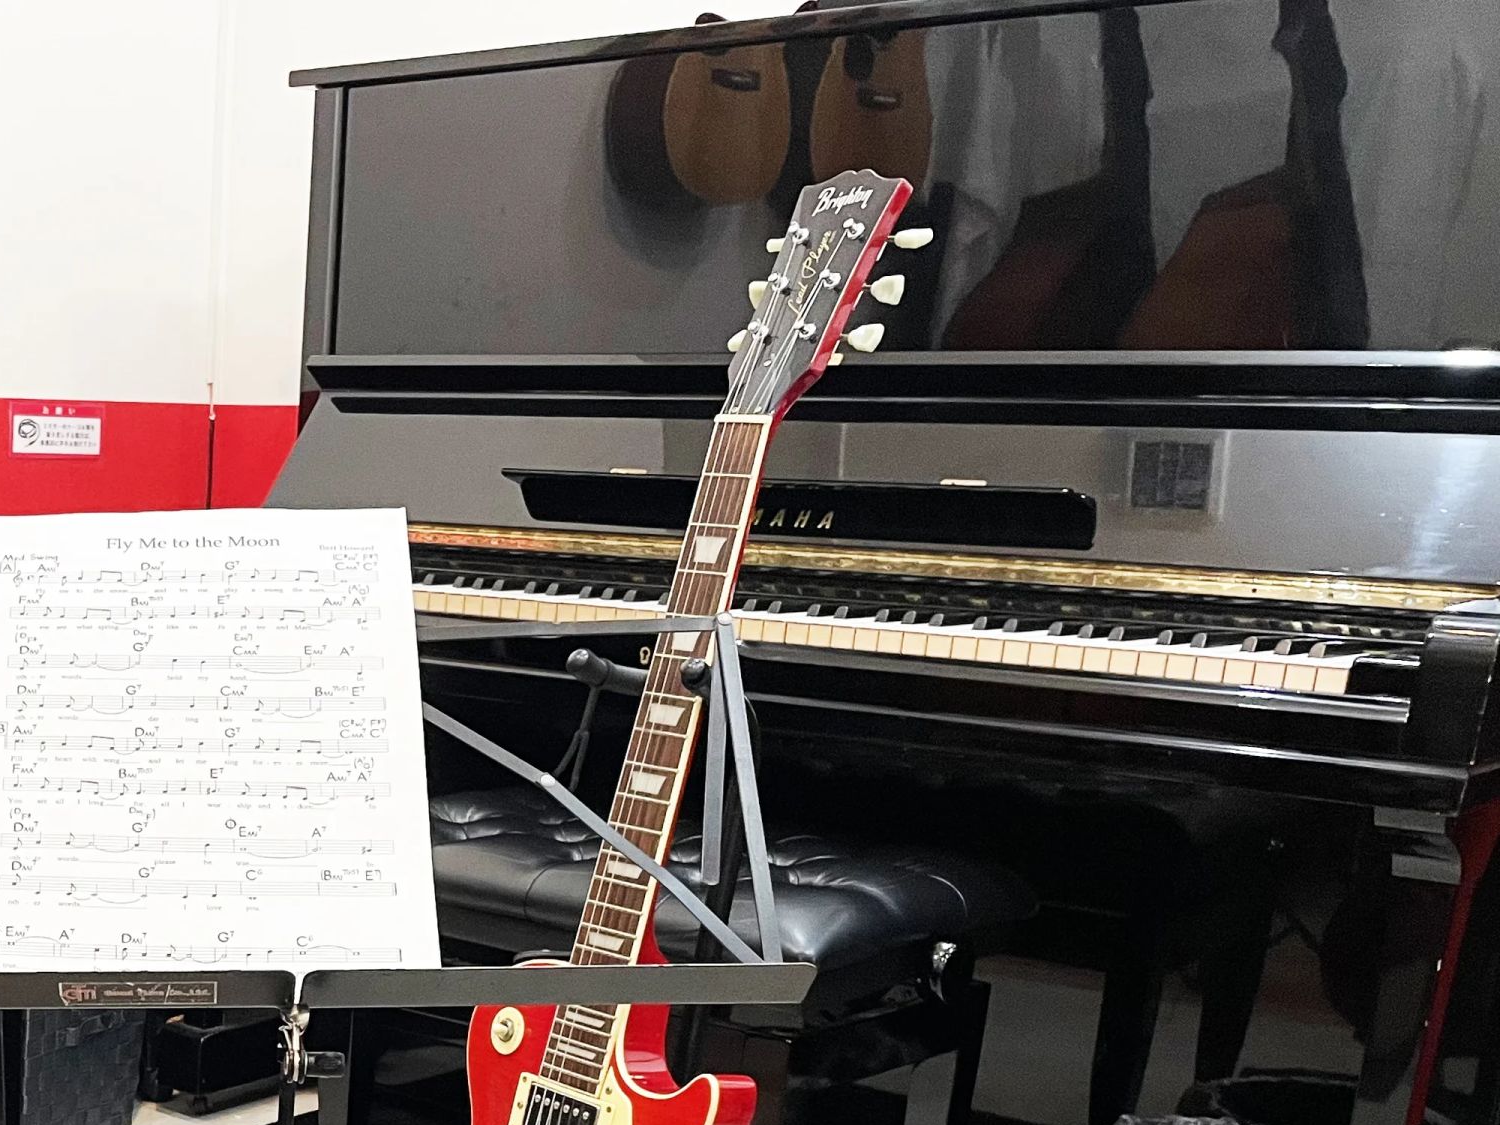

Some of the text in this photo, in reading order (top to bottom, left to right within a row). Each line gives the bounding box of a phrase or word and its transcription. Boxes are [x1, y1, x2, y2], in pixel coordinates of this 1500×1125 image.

[107, 536, 280, 552] Fly Me to the Moon
